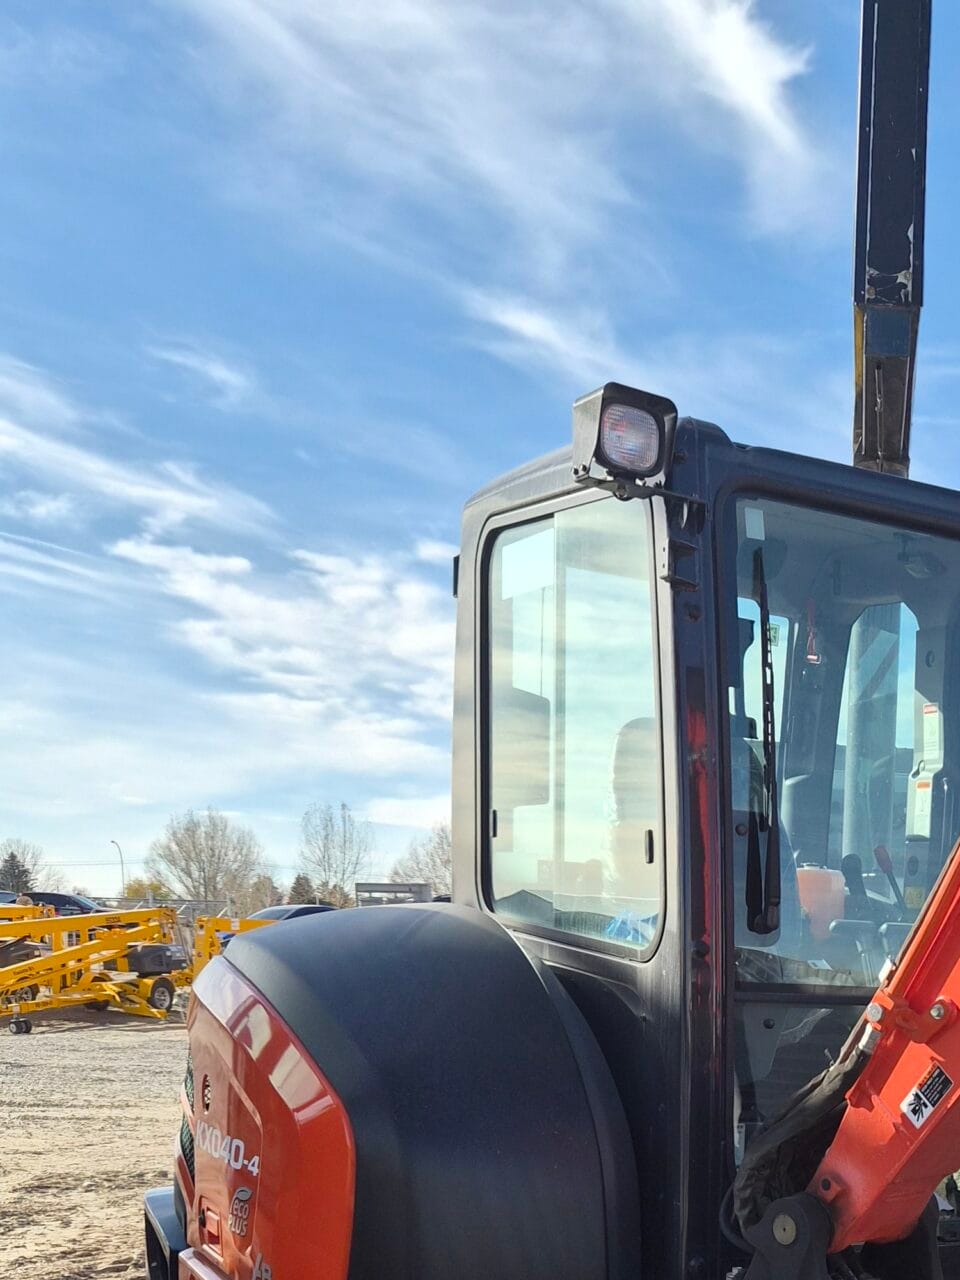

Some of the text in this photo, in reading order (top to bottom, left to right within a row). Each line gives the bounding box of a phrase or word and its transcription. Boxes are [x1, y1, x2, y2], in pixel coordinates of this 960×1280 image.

[194, 1119, 260, 1177] KX040-4
[233, 1201, 250, 1219] eco
[228, 1216, 248, 1237] PLUS
